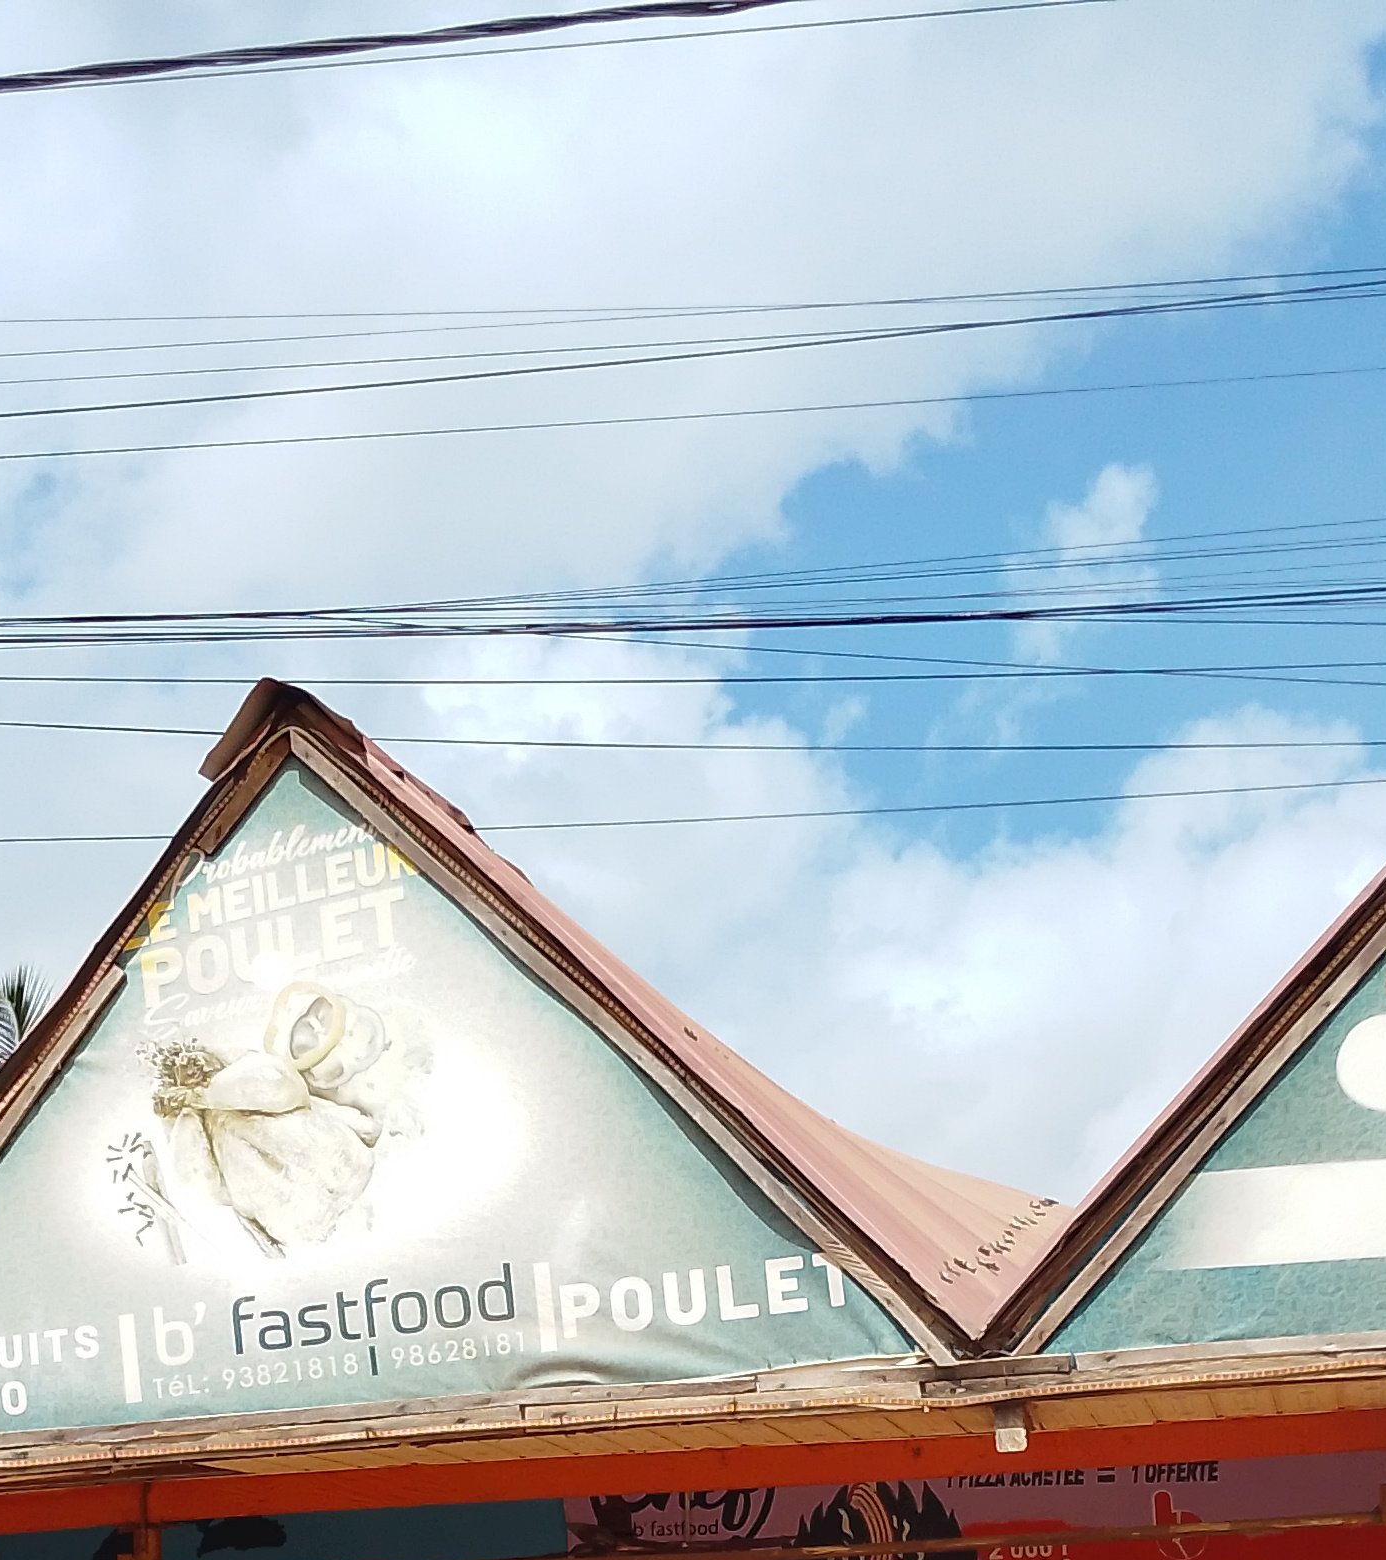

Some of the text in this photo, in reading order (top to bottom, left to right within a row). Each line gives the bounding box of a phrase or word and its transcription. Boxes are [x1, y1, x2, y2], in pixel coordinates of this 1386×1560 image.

[173, 822, 376, 901] Probablemen
[140, 886, 405, 1010] POULET
[232, 1262, 516, 1356] fastfood
[557, 1252, 848, 1340] POULET
[221, 1352, 360, 1392] 93821818
[390, 1332, 527, 1370] 98628181
[650, 1519, 720, 1537] fastfood
